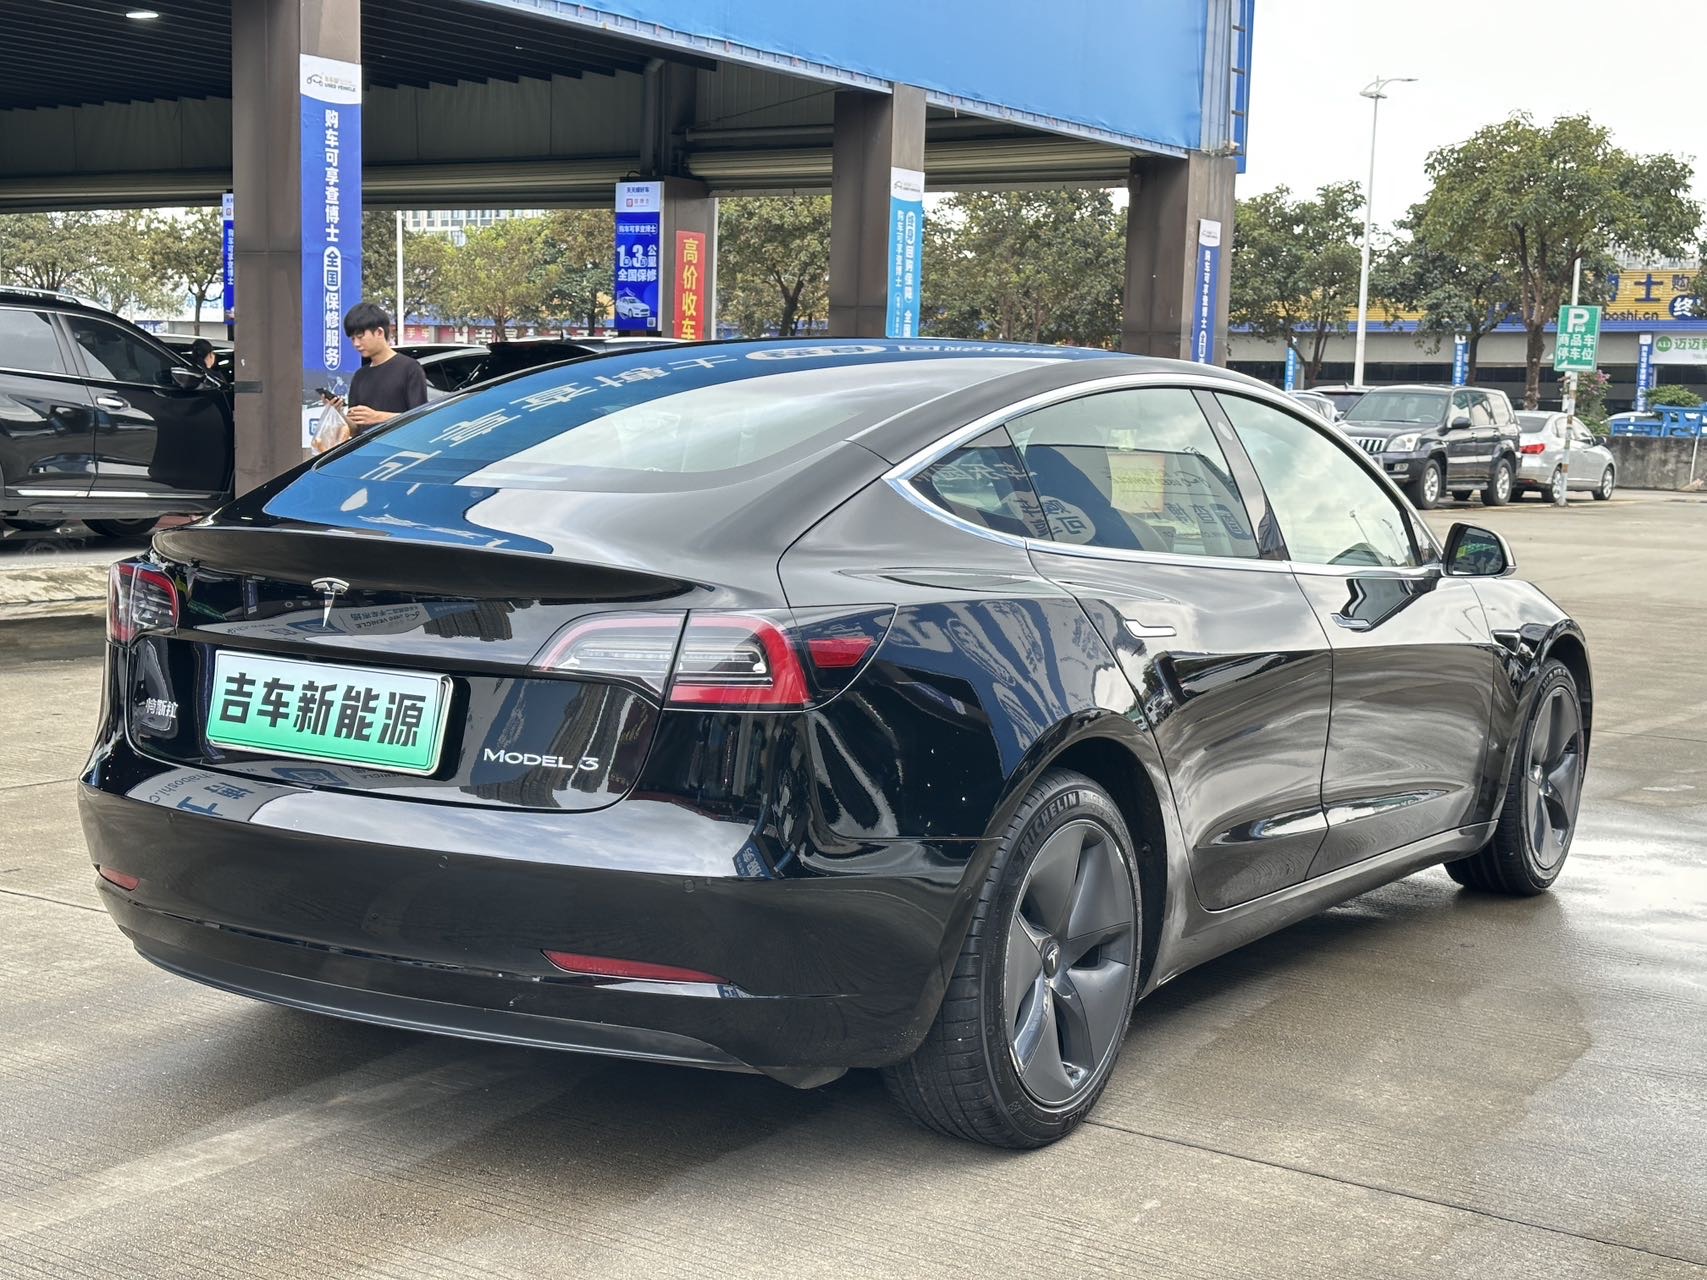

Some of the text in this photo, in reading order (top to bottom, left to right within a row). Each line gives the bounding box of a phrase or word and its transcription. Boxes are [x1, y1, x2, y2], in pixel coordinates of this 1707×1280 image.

[325, 109, 340, 242] 购车可享查博士
[617, 268, 657, 282] 全国保修
[681, 238, 699, 340] 高价收车
[1567, 308, 1590, 333] P
[1558, 333, 1595, 347] 商品车
[1557, 347, 1594, 360] 停车位
[145, 698, 179, 718] 特斯拉
[219, 672, 427, 747] 吉车新能源
[483, 748, 599, 771] MODEL 3
[1019, 790, 1080, 859] MICHELIN
